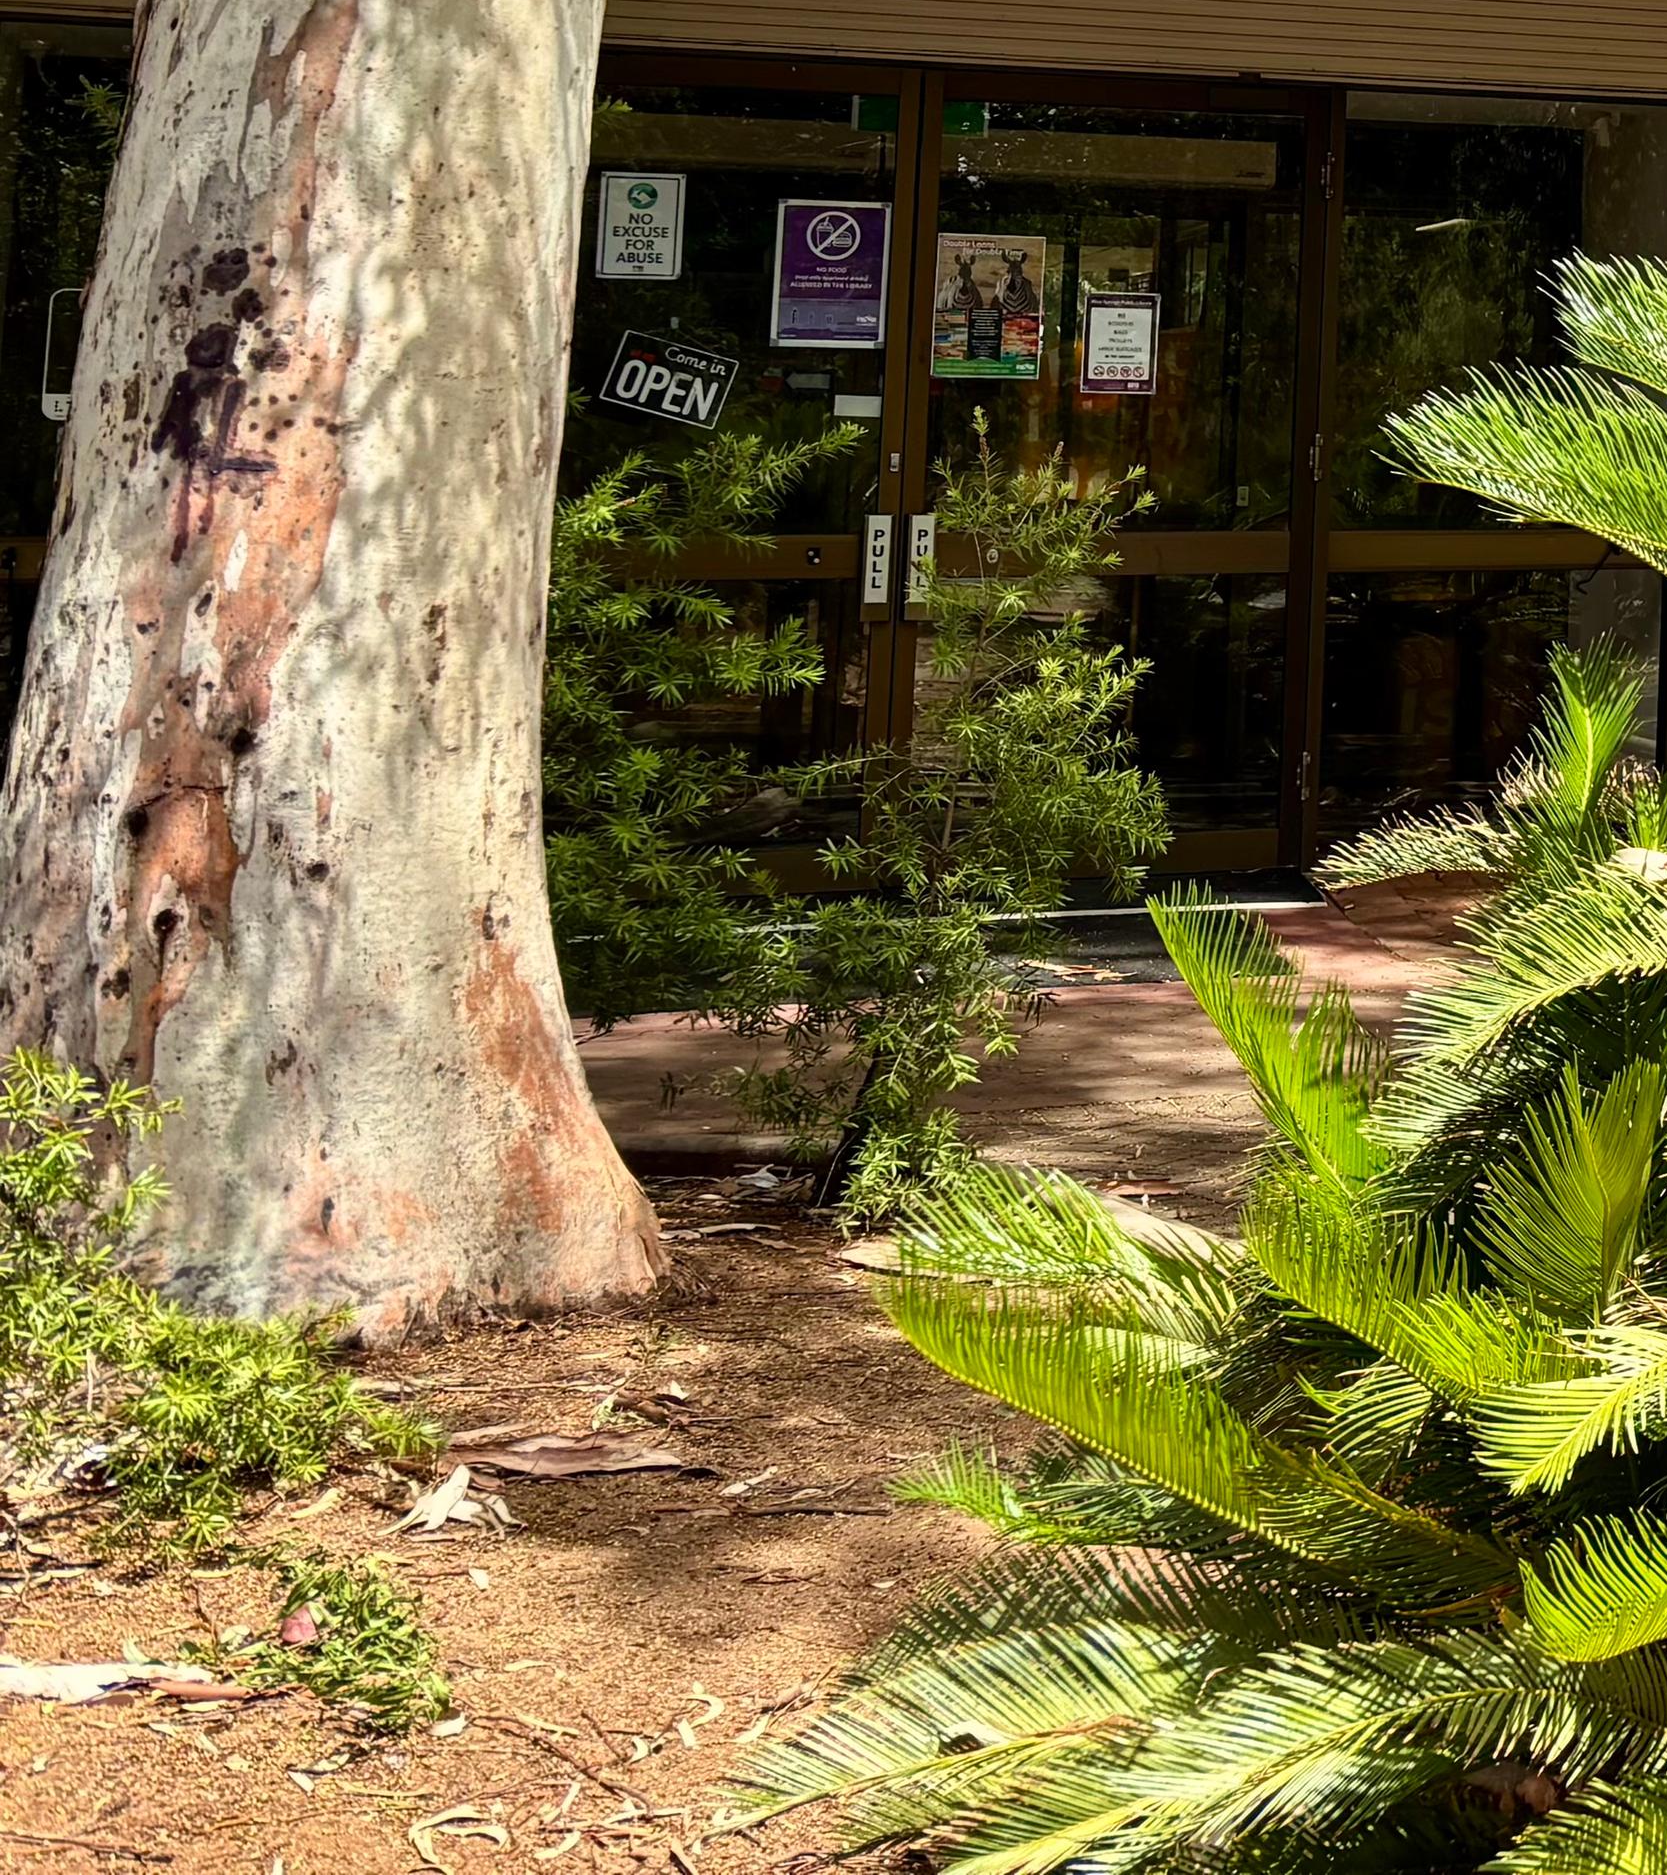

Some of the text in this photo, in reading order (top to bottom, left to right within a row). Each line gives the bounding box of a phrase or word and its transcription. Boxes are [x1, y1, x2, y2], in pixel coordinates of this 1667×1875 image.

[628, 213, 653, 225] NO
[612, 226, 669, 238] EXCUSE
[625, 239, 655, 251] FOR
[616, 252, 663, 264] ABUSE
[665, 346, 708, 370] Come
[710, 359, 726, 376] in
[615, 359, 719, 421] OPEN
[871, 529, 885, 589] PULL
